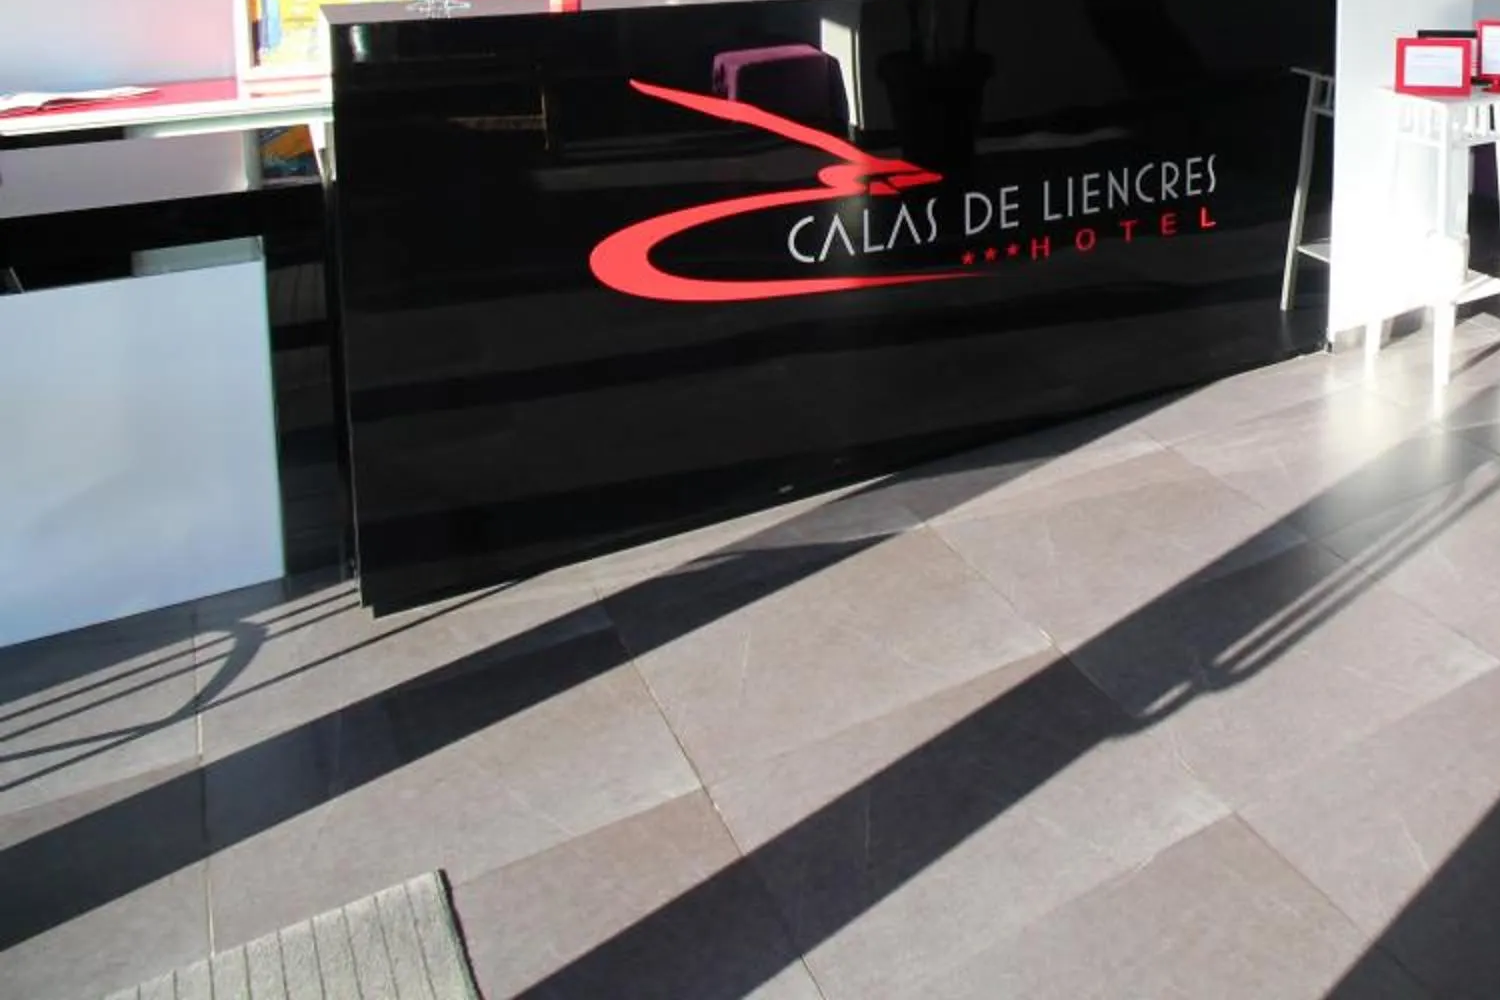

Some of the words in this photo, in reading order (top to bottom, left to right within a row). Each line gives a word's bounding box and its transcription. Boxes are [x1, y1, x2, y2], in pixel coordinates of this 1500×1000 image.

[787, 198, 937, 263] CALAS
[964, 186, 1019, 235] DE
[1043, 154, 1217, 221] LIENCRES
[1030, 207, 1217, 261] HOTEL
